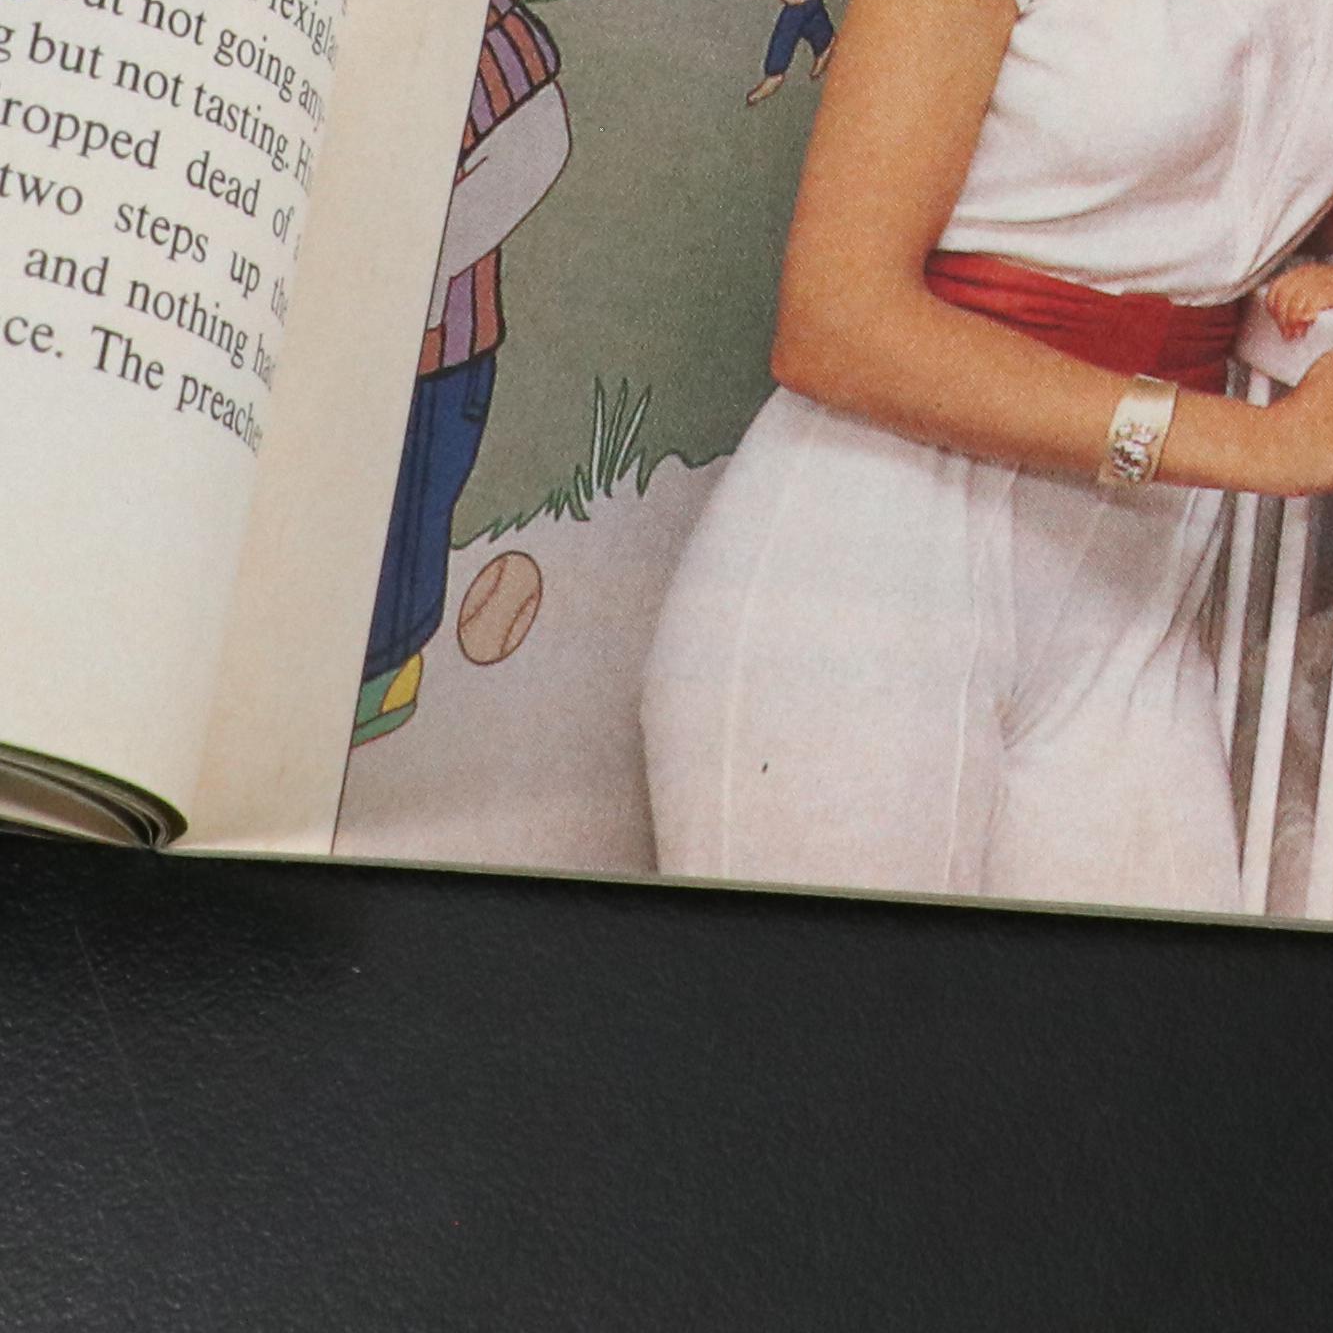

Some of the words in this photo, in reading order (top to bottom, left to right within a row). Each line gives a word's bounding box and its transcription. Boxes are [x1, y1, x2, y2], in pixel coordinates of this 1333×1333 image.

[28, 21, 104, 80] but
[113, 59, 184, 108] not
[193, 83, 289, 173] tasting.
[114, 202, 209, 264] steps
[229, 249, 261, 299] up
[90, 325, 165, 391] The
